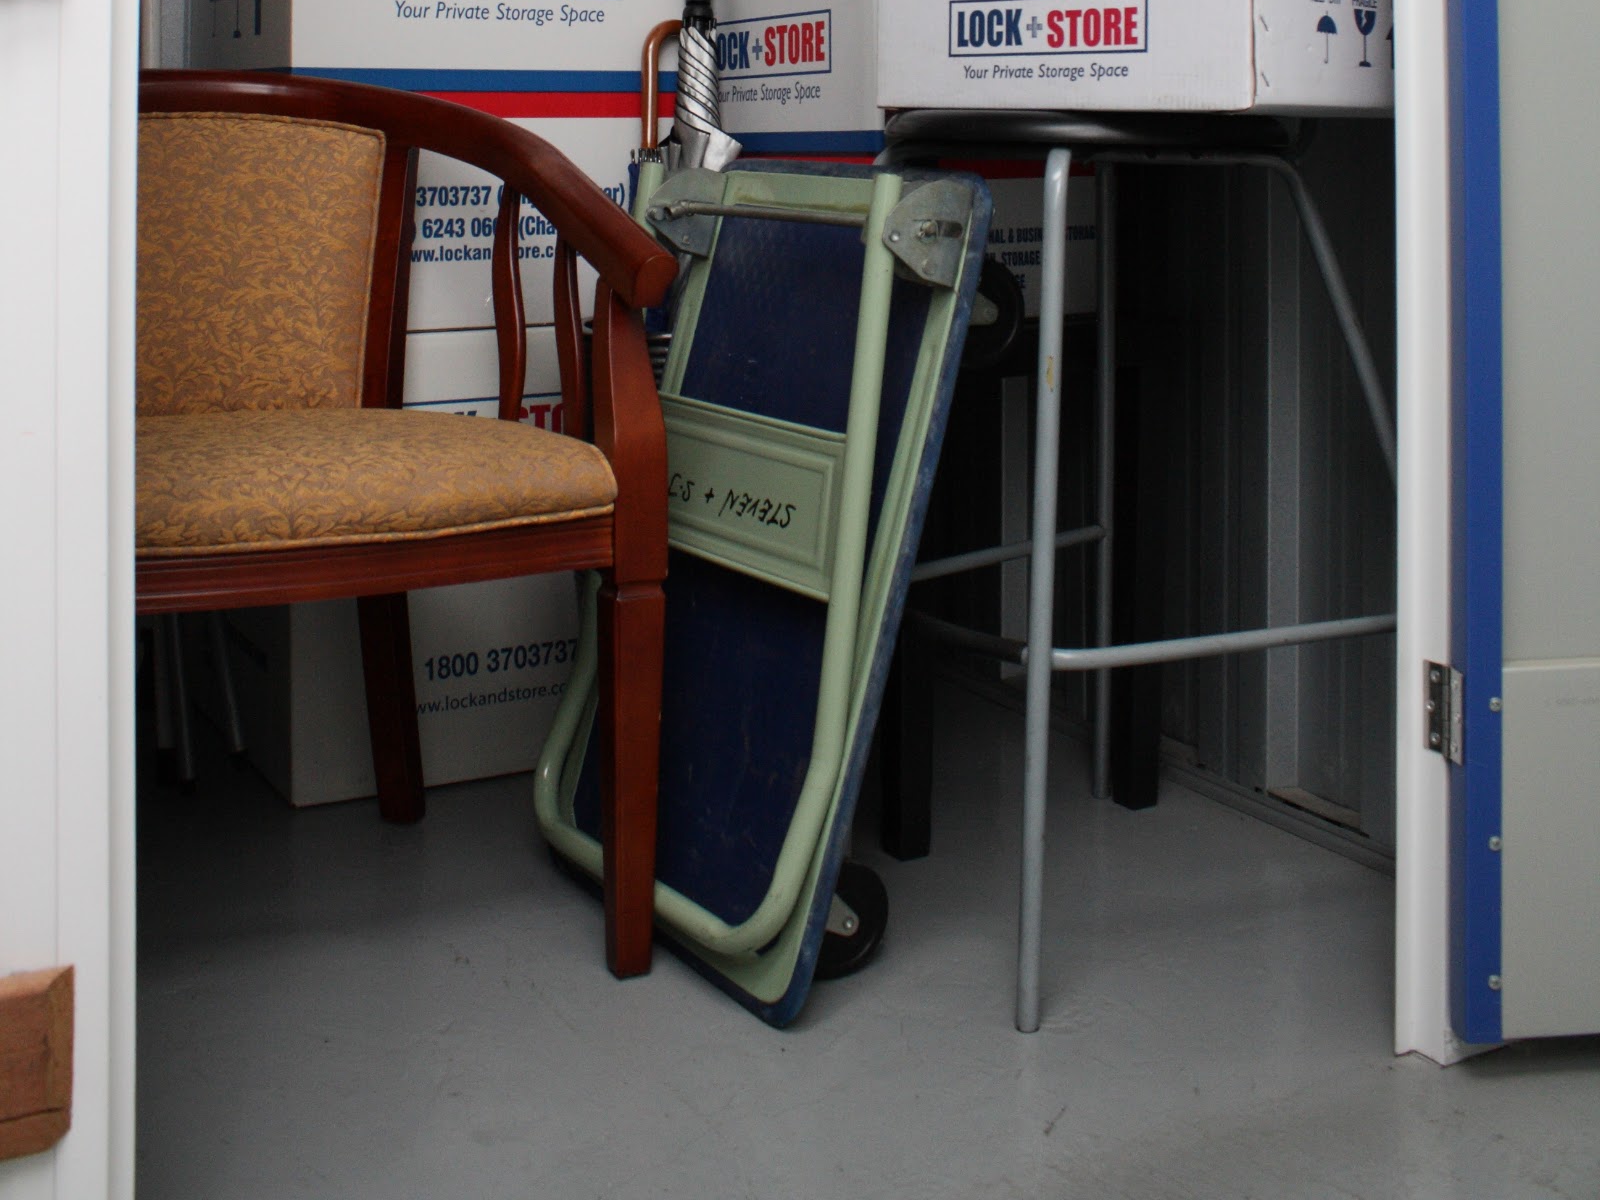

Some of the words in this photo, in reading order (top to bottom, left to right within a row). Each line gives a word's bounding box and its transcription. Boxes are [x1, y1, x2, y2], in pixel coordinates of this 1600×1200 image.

[394, 0, 431, 19] Your
[436, 1, 490, 20] Private
[496, 2, 554, 26] Storage
[560, 4, 605, 26] Space
[963, 65, 988, 79] Your
[992, 64, 1033, 79] Private
[1038, 63, 1084, 81] Storage
[1090, 62, 1129, 81] Space
[717, 90, 730, 103] our
[732, 85, 757, 102] Private
[760, 83, 791, 105] Storage
[794, 81, 821, 105] Space
[416, 186, 492, 207] 3703737
[422, 218, 465, 239] 6243
[518, 215, 555, 240] (Cha
[1017, 226, 1043, 243] BUSIN
[718, 489, 797, 528] STEVEN
[425, 652, 479, 681] 1800
[486, 639, 578, 672] 3703737
